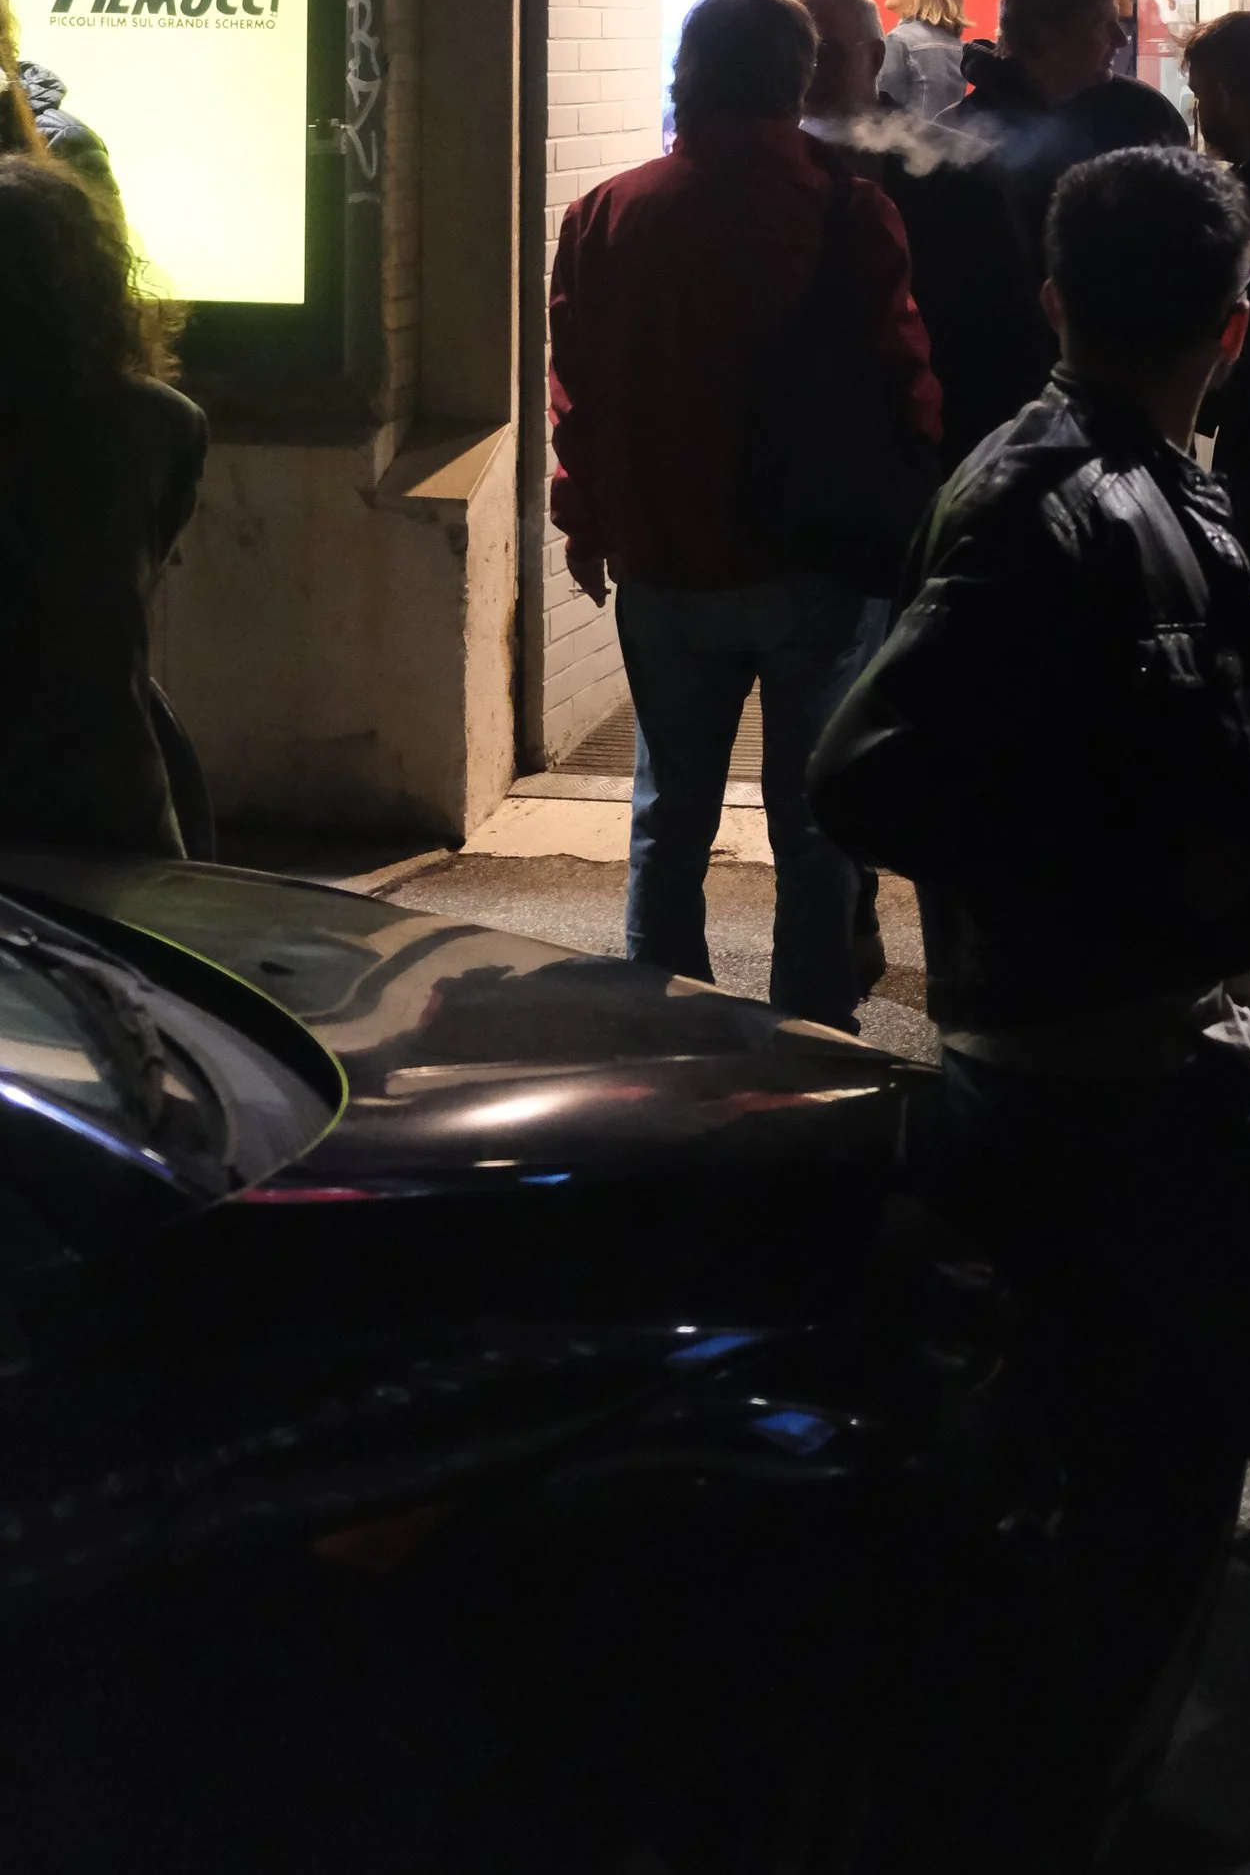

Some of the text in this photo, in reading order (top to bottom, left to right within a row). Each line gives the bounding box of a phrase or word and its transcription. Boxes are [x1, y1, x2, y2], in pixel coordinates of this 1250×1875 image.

[49, 15, 277, 30] PICCOLI FILM SUL GRANDE SCHERMO
